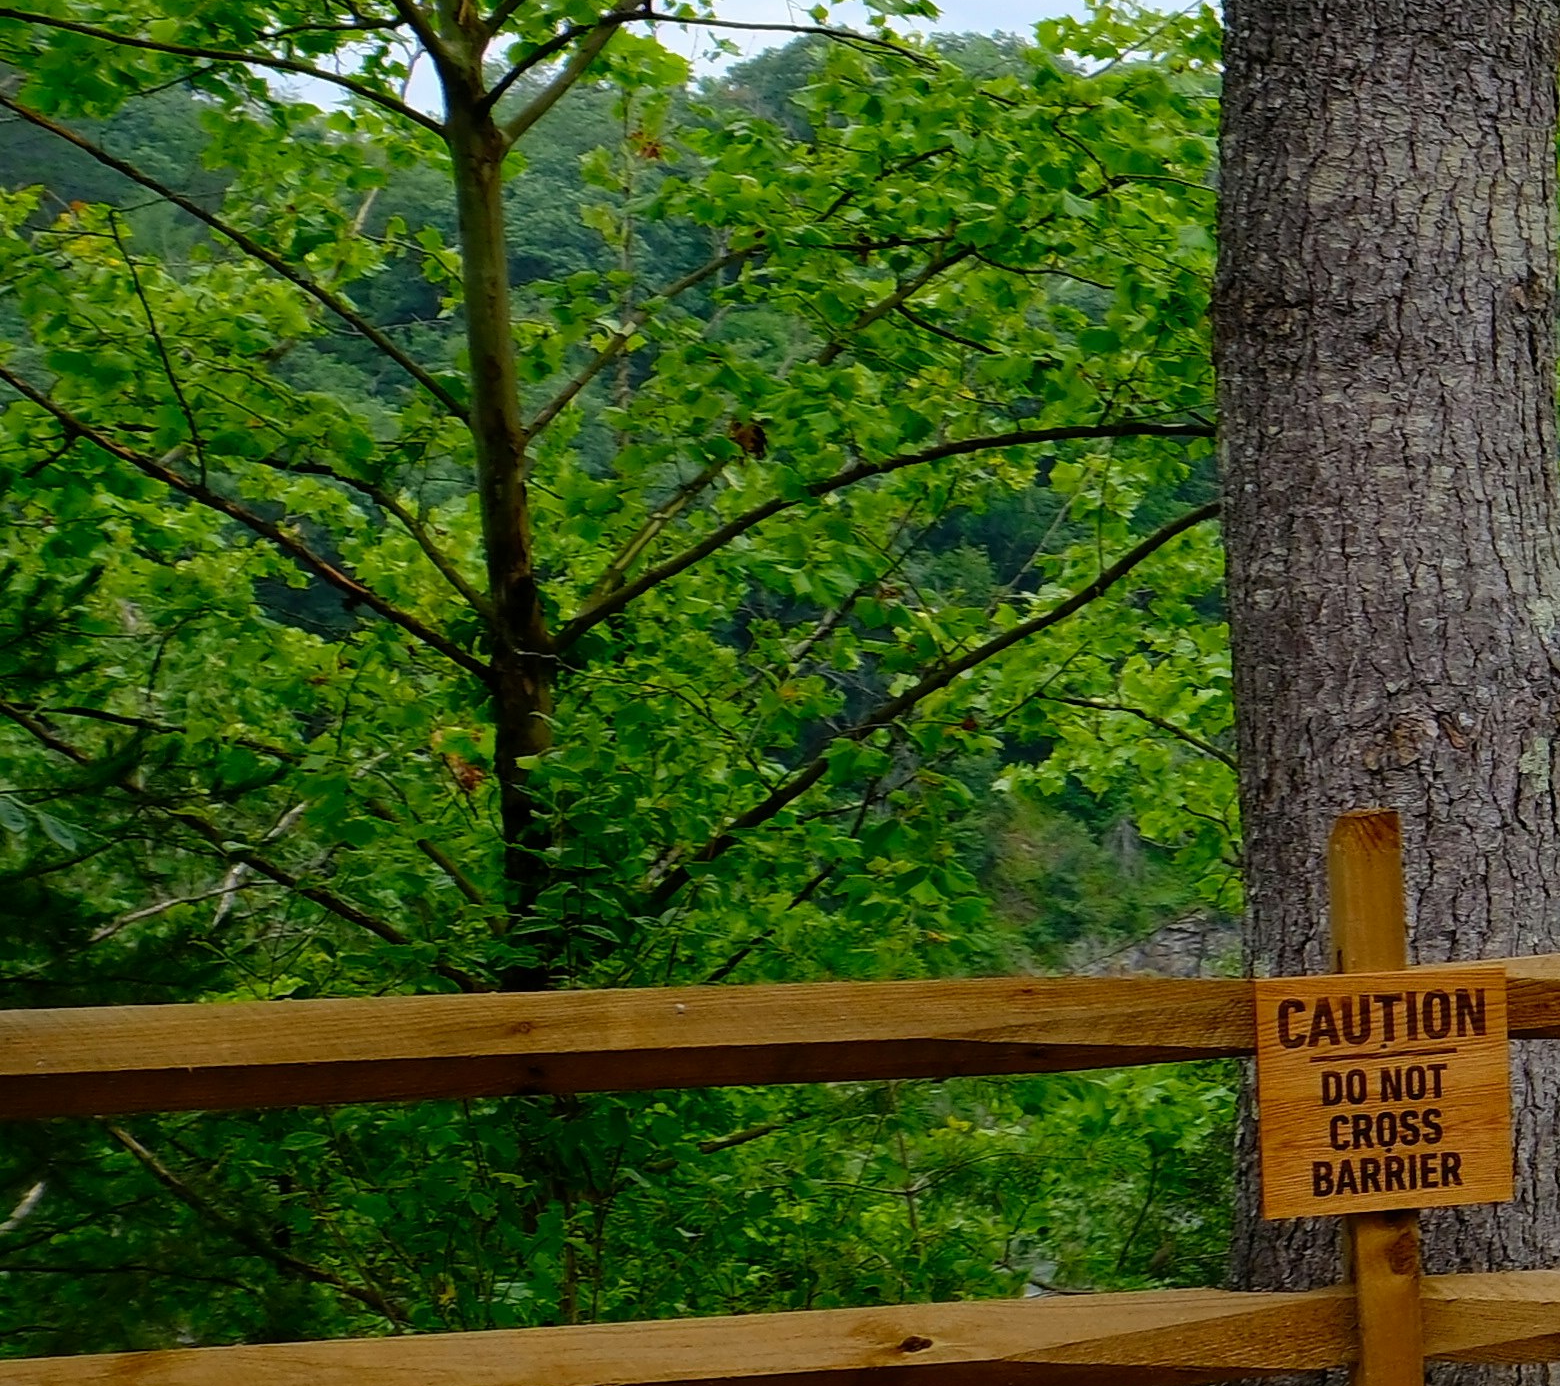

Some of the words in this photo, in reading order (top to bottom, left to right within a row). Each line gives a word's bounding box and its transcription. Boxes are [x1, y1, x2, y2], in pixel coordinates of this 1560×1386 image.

[1277, 988, 1487, 1049] CAUTION
[1321, 1069, 1367, 1106] DO
[1380, 1063, 1447, 1103] NOT
[1329, 1108, 1443, 1151] CROSS
[1312, 1152, 1463, 1197] BARRIER
